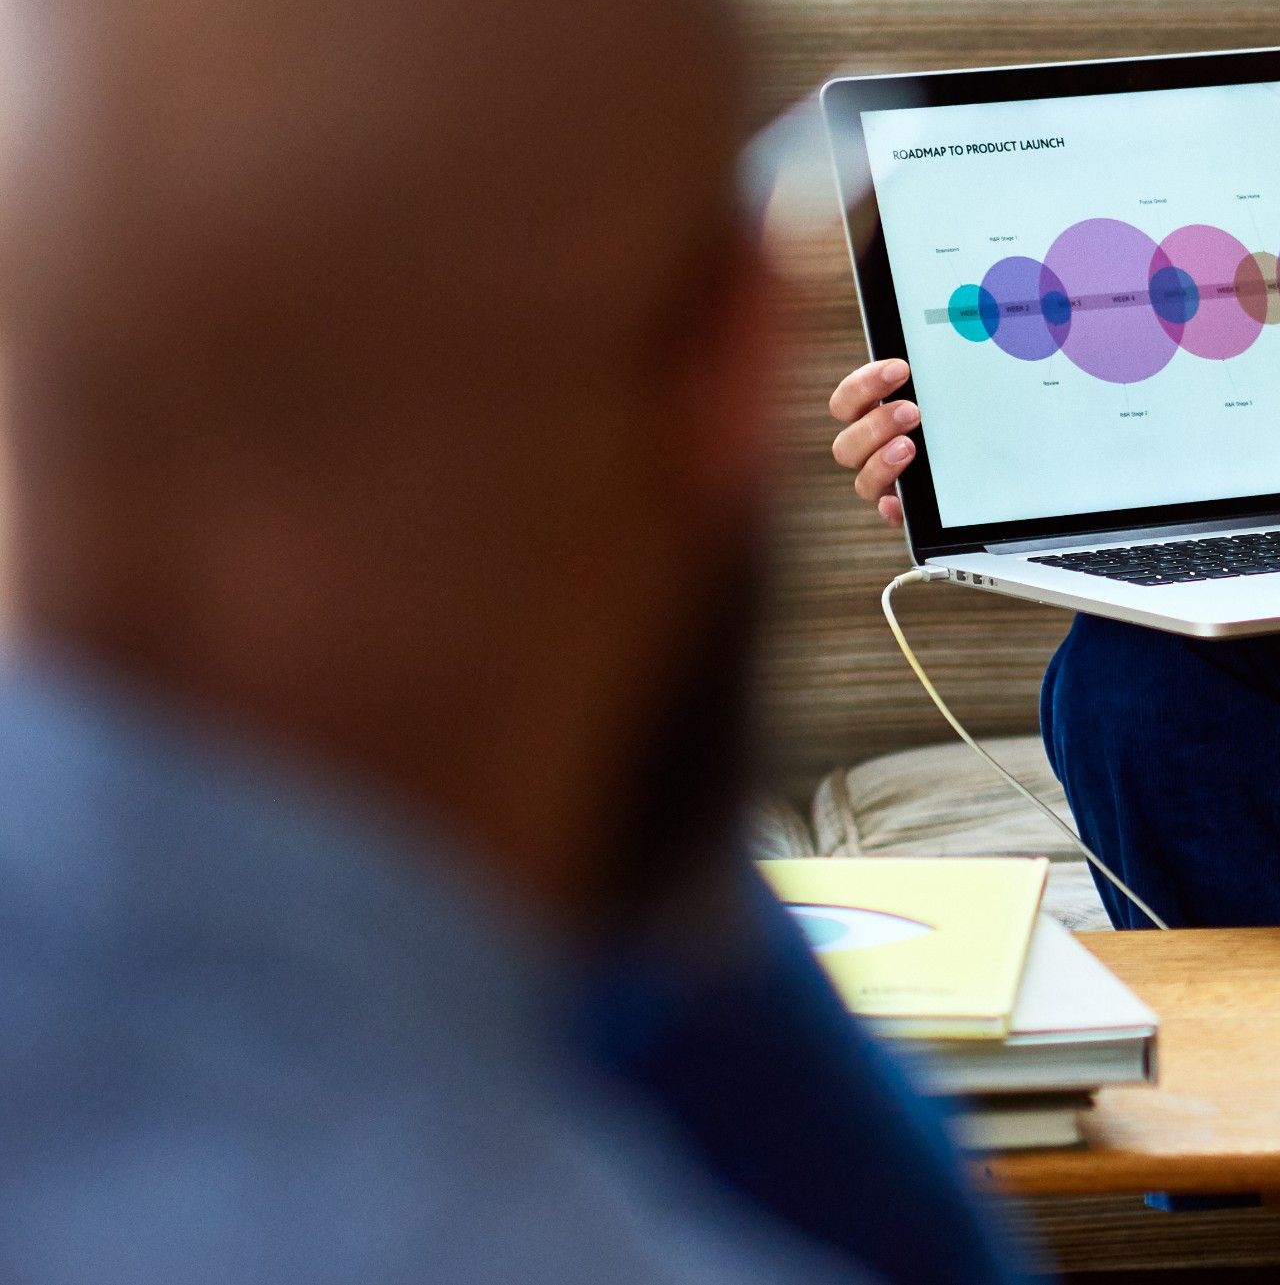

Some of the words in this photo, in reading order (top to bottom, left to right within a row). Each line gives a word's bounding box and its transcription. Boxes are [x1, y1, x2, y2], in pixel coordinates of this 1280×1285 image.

[892, 146, 947, 160] ROADMAP
[948, 144, 964, 156] TO
[966, 140, 1018, 155] PRODUCT
[1019, 137, 1066, 151] LAUNCH
[1112, 295, 1130, 303] WEEK
[1006, 305, 1024, 313] WEEK
